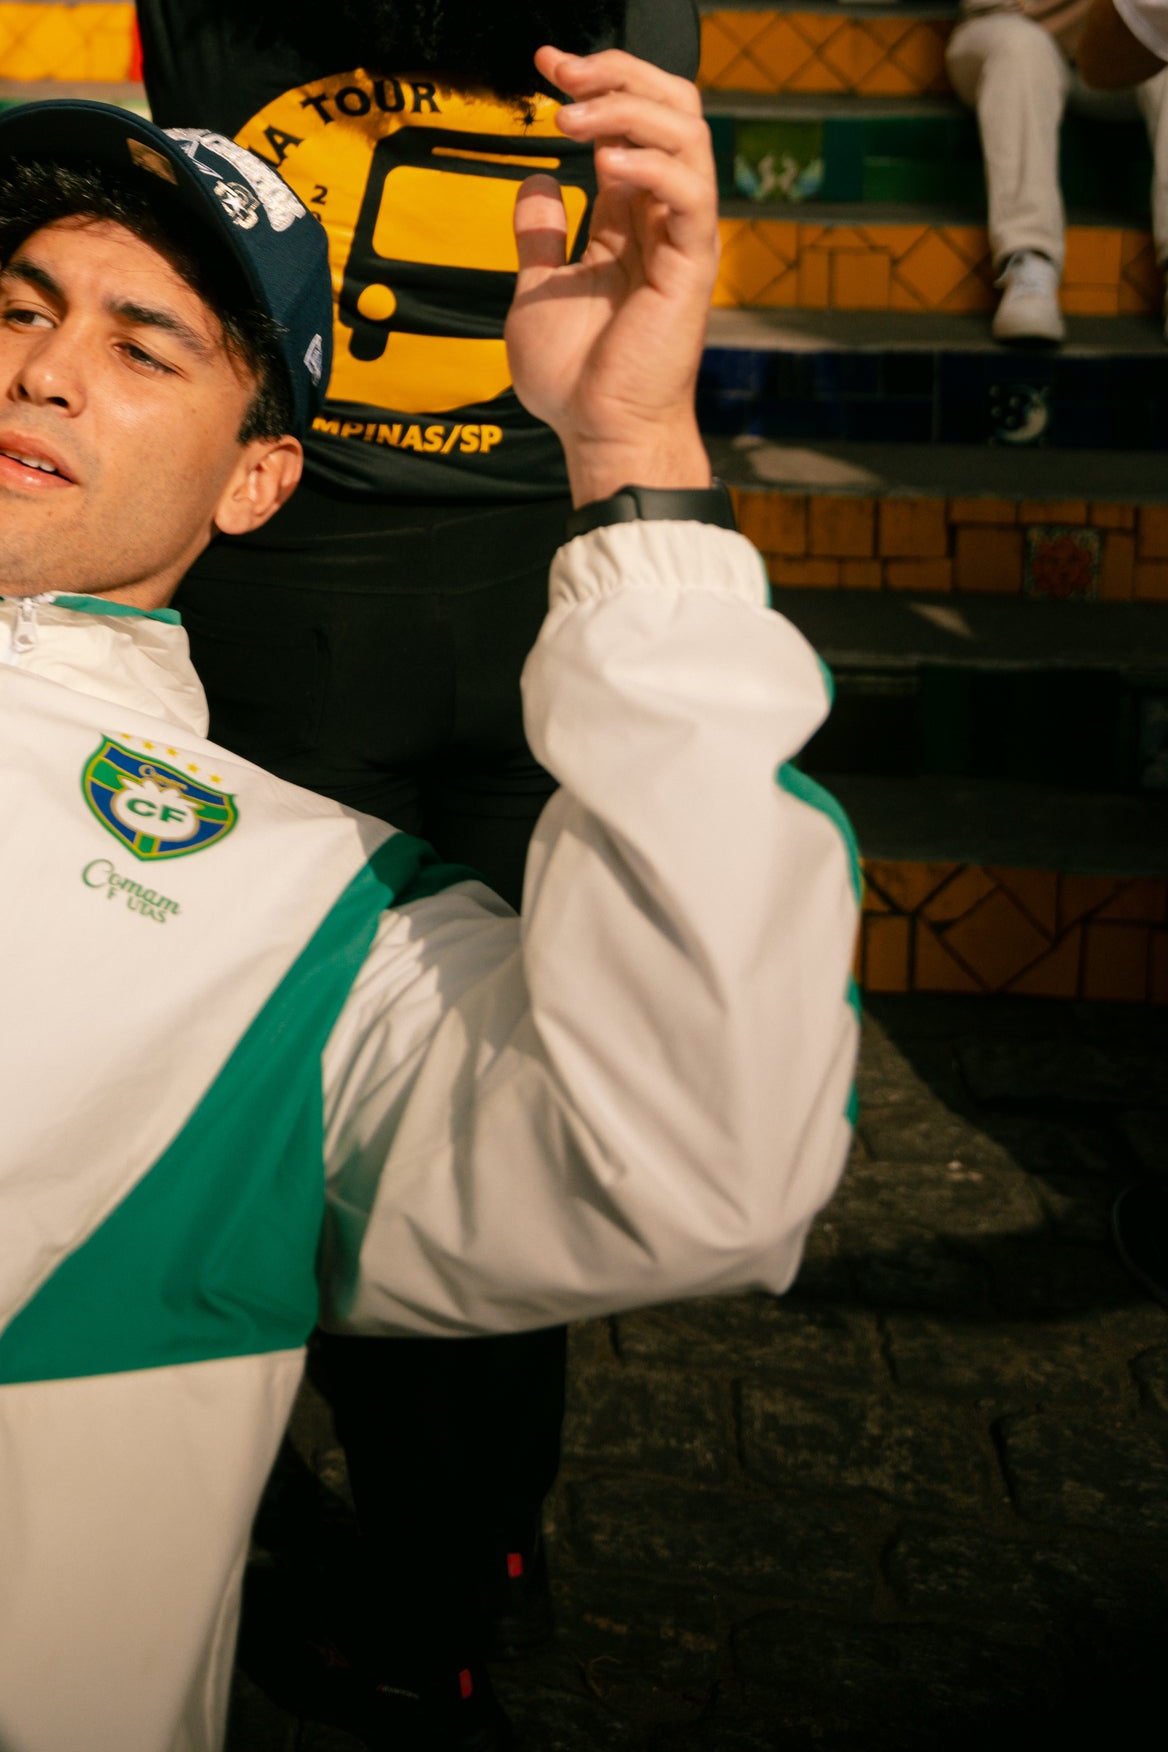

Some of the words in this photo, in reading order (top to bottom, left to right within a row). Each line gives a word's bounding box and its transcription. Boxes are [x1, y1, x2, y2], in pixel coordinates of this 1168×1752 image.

[301, 79, 441, 125] TOUR
[311, 416, 503, 454] MPINAS/SP
[126, 798, 187, 823] CF
[82, 859, 180, 914] Comam
[107, 887, 166, 923] FUTAS
